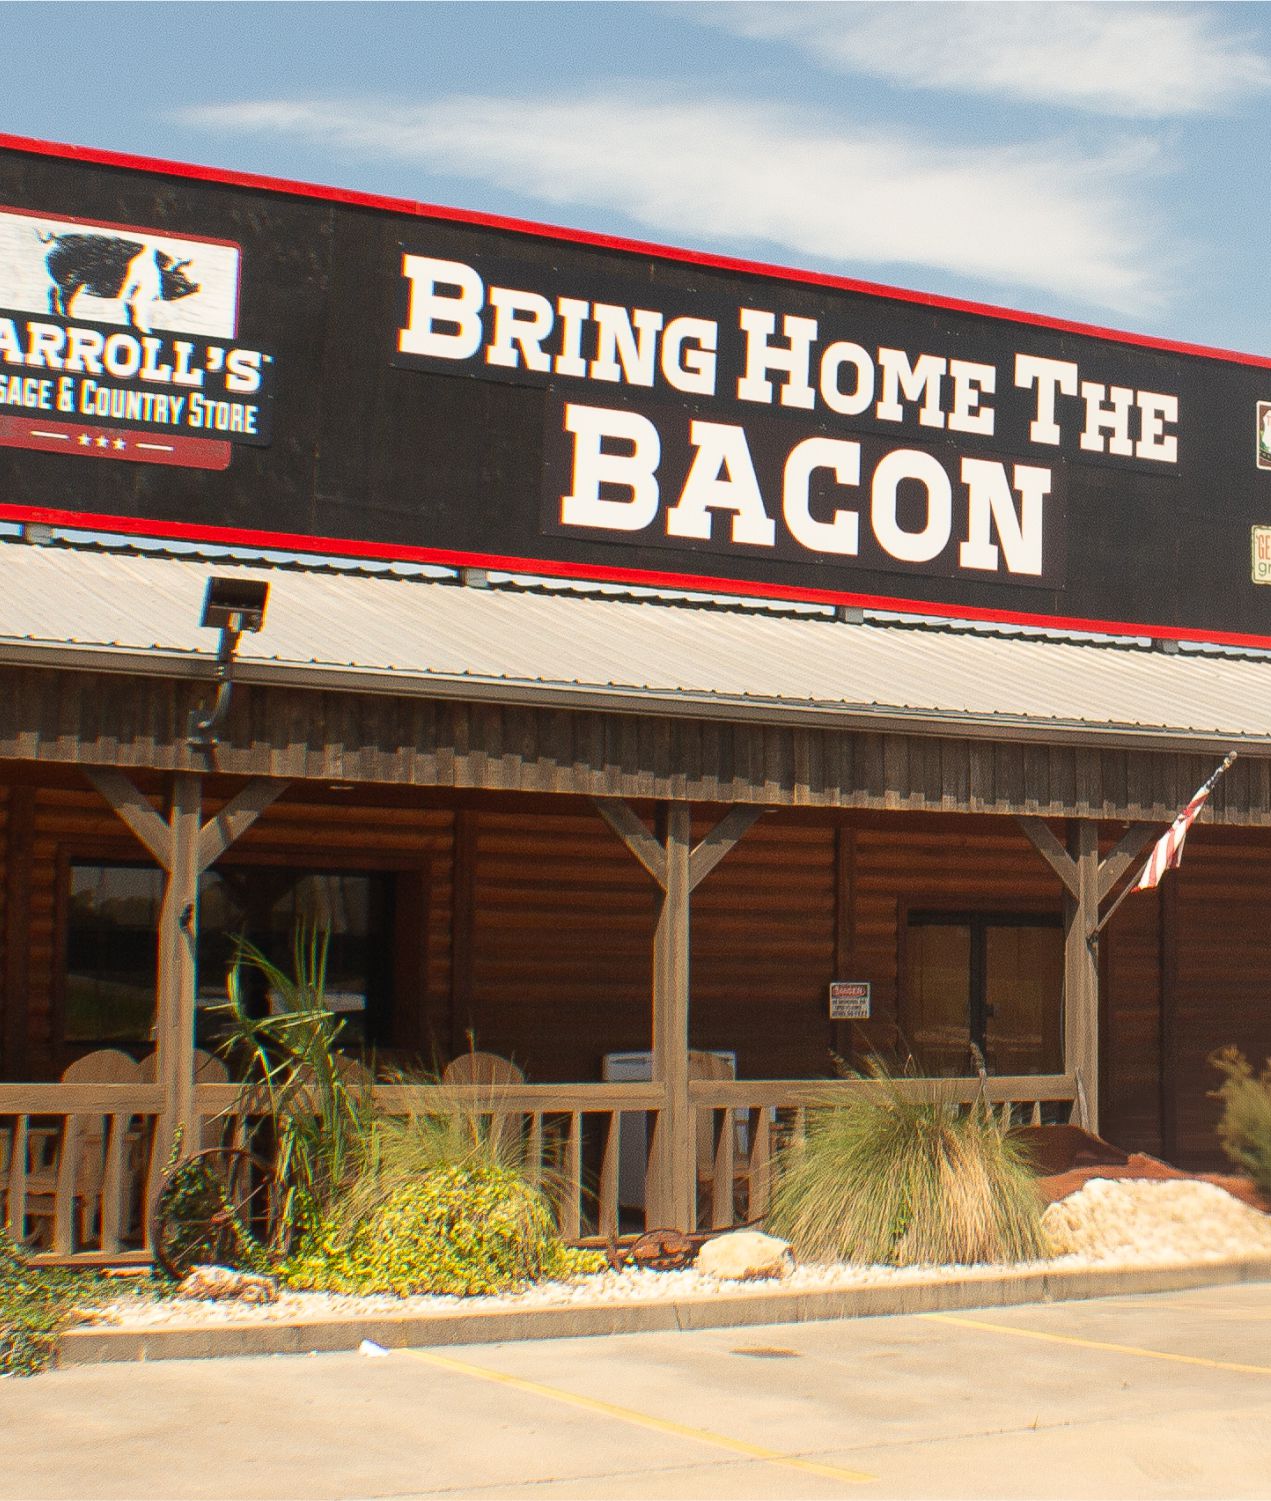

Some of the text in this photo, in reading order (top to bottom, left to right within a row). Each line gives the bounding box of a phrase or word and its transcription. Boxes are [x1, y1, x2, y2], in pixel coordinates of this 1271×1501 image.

[56, 376, 75, 412] &
[80, 379, 183, 425] COUNTRY
[188, 392, 258, 434] STORE
[397, 253, 1178, 463] BRING HOME THE
[561, 402, 1052, 576] BACON
